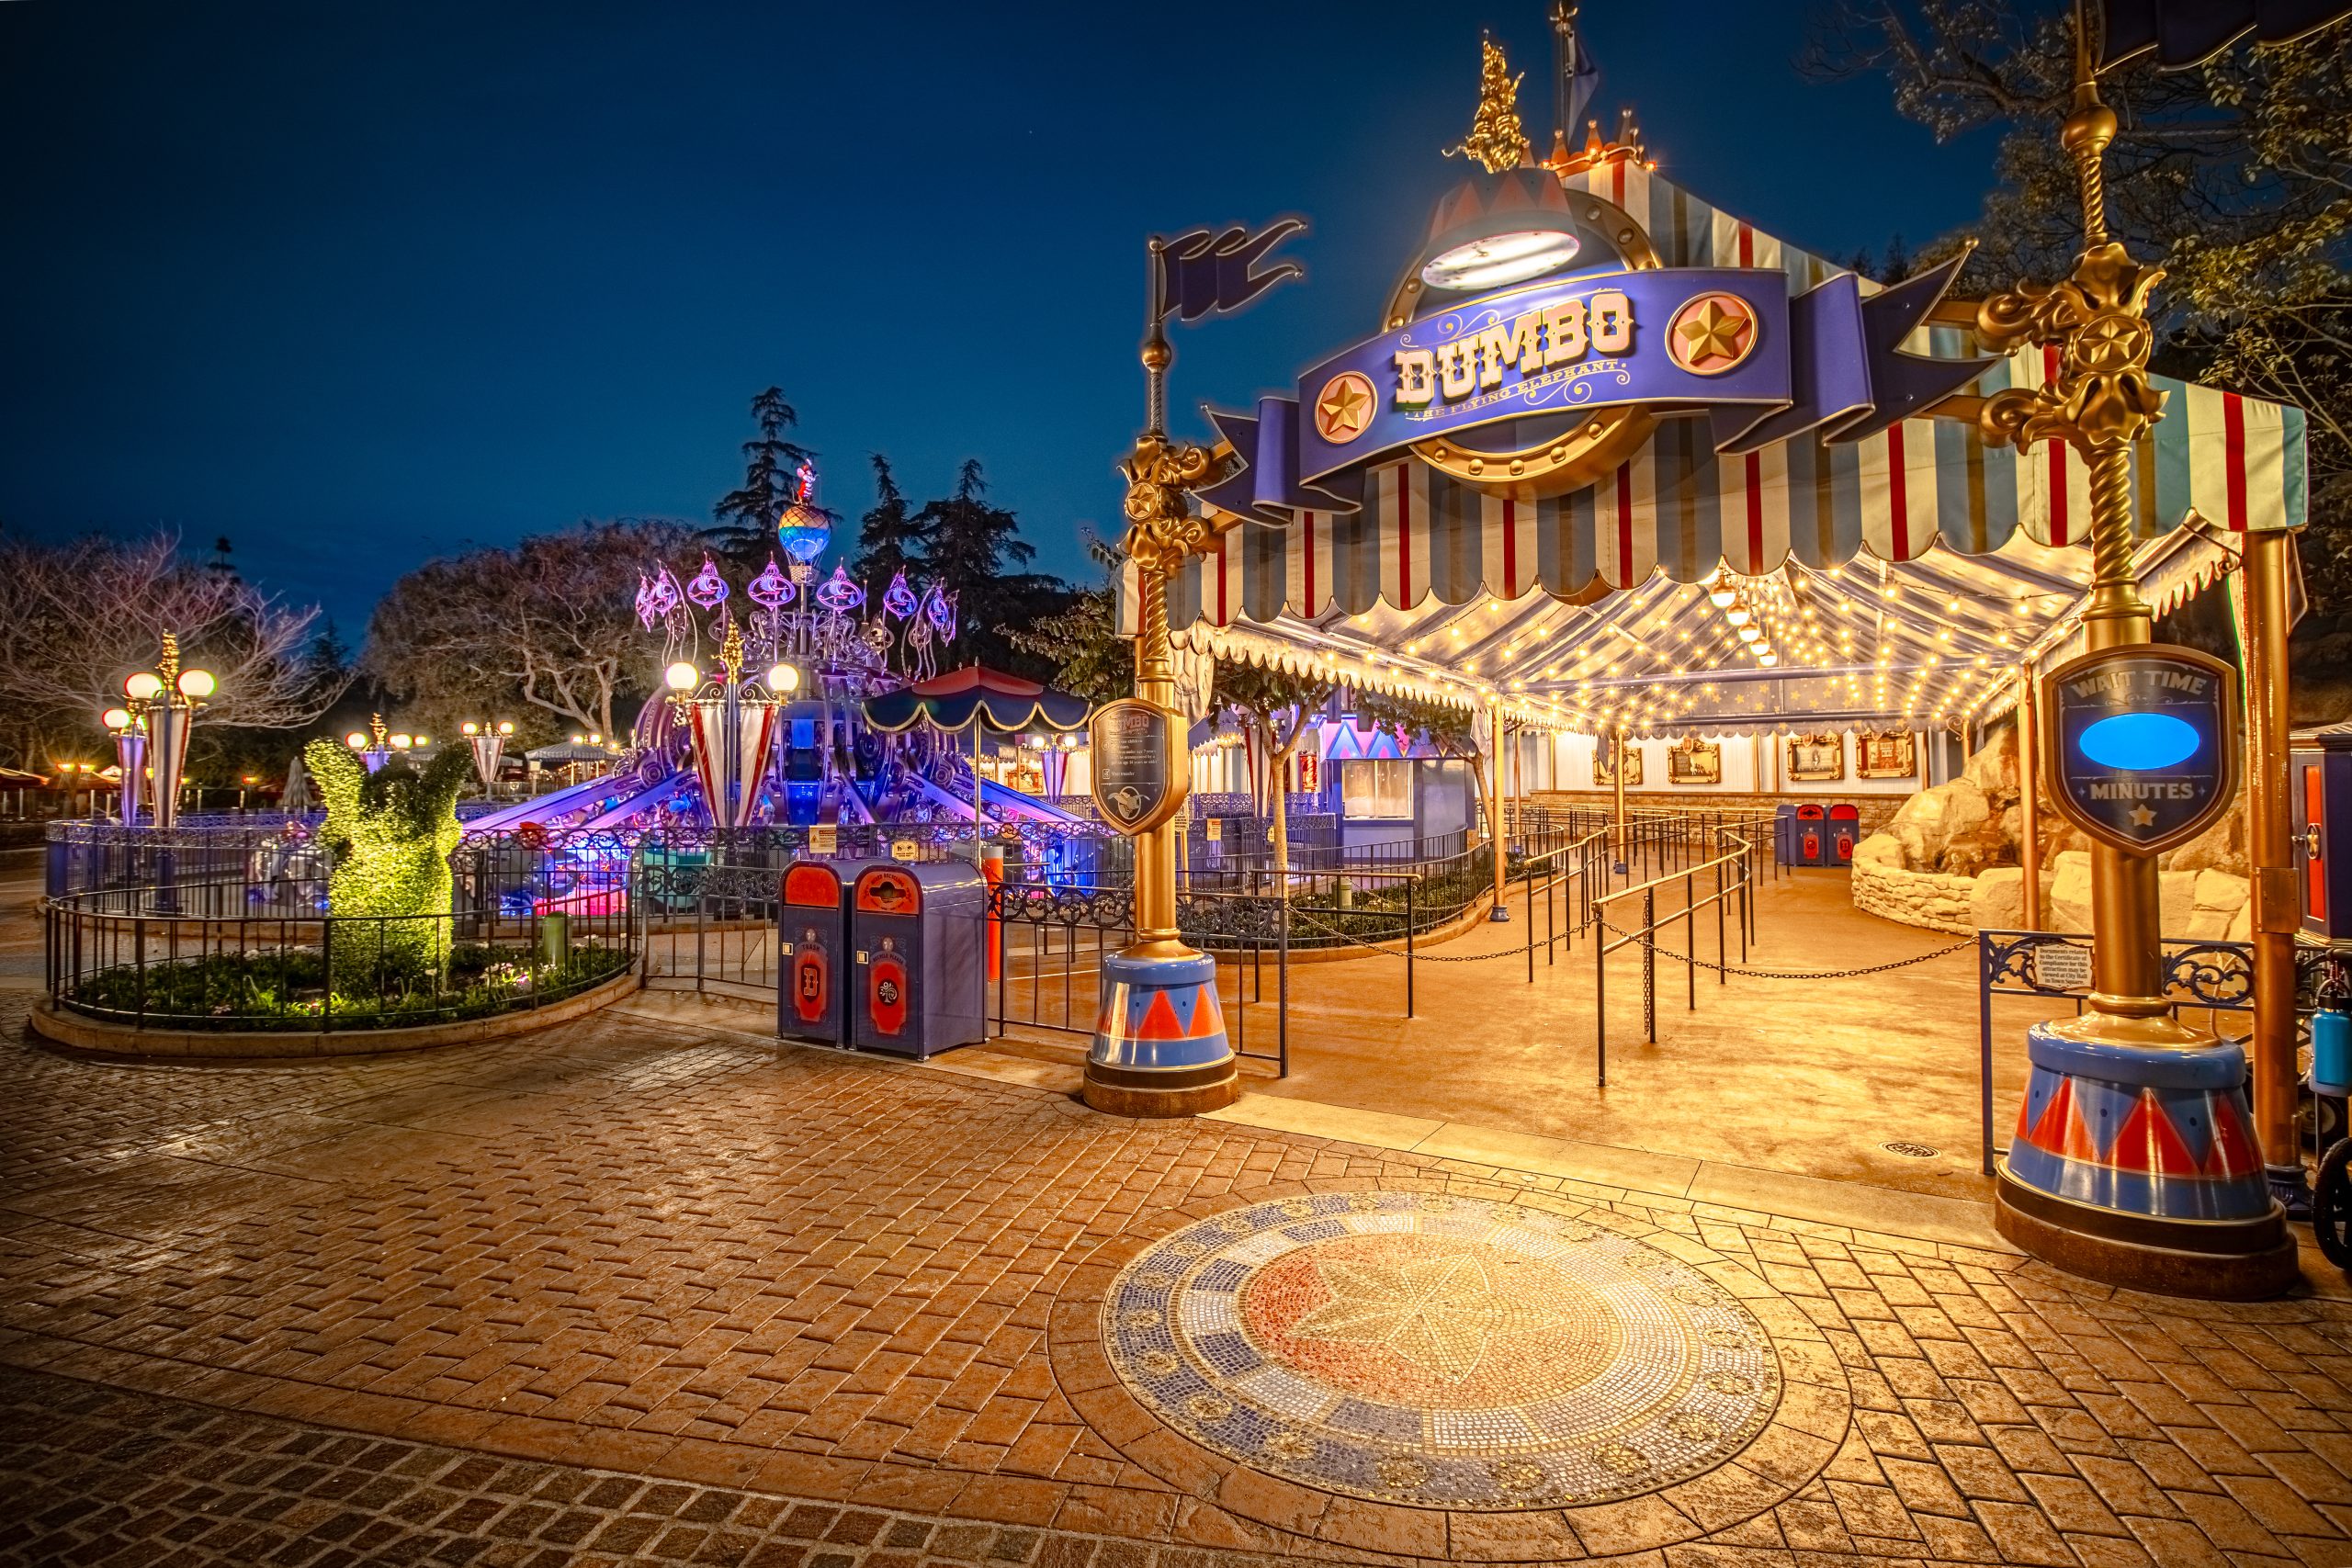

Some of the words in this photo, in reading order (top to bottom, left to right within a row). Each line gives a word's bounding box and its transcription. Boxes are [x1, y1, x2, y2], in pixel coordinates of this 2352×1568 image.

[1395, 292, 1634, 404] DUMBO
[1413, 408, 1445, 419] THE
[1450, 389, 1510, 414] FLYING
[1517, 361, 1619, 393] ELEPHANT
[2071, 671, 2136, 699] WAIT
[2143, 671, 2208, 695] TIME
[2089, 784, 2195, 800] MINUTES
[801, 943, 820, 952] TRASH
[804, 967, 819, 996] D
